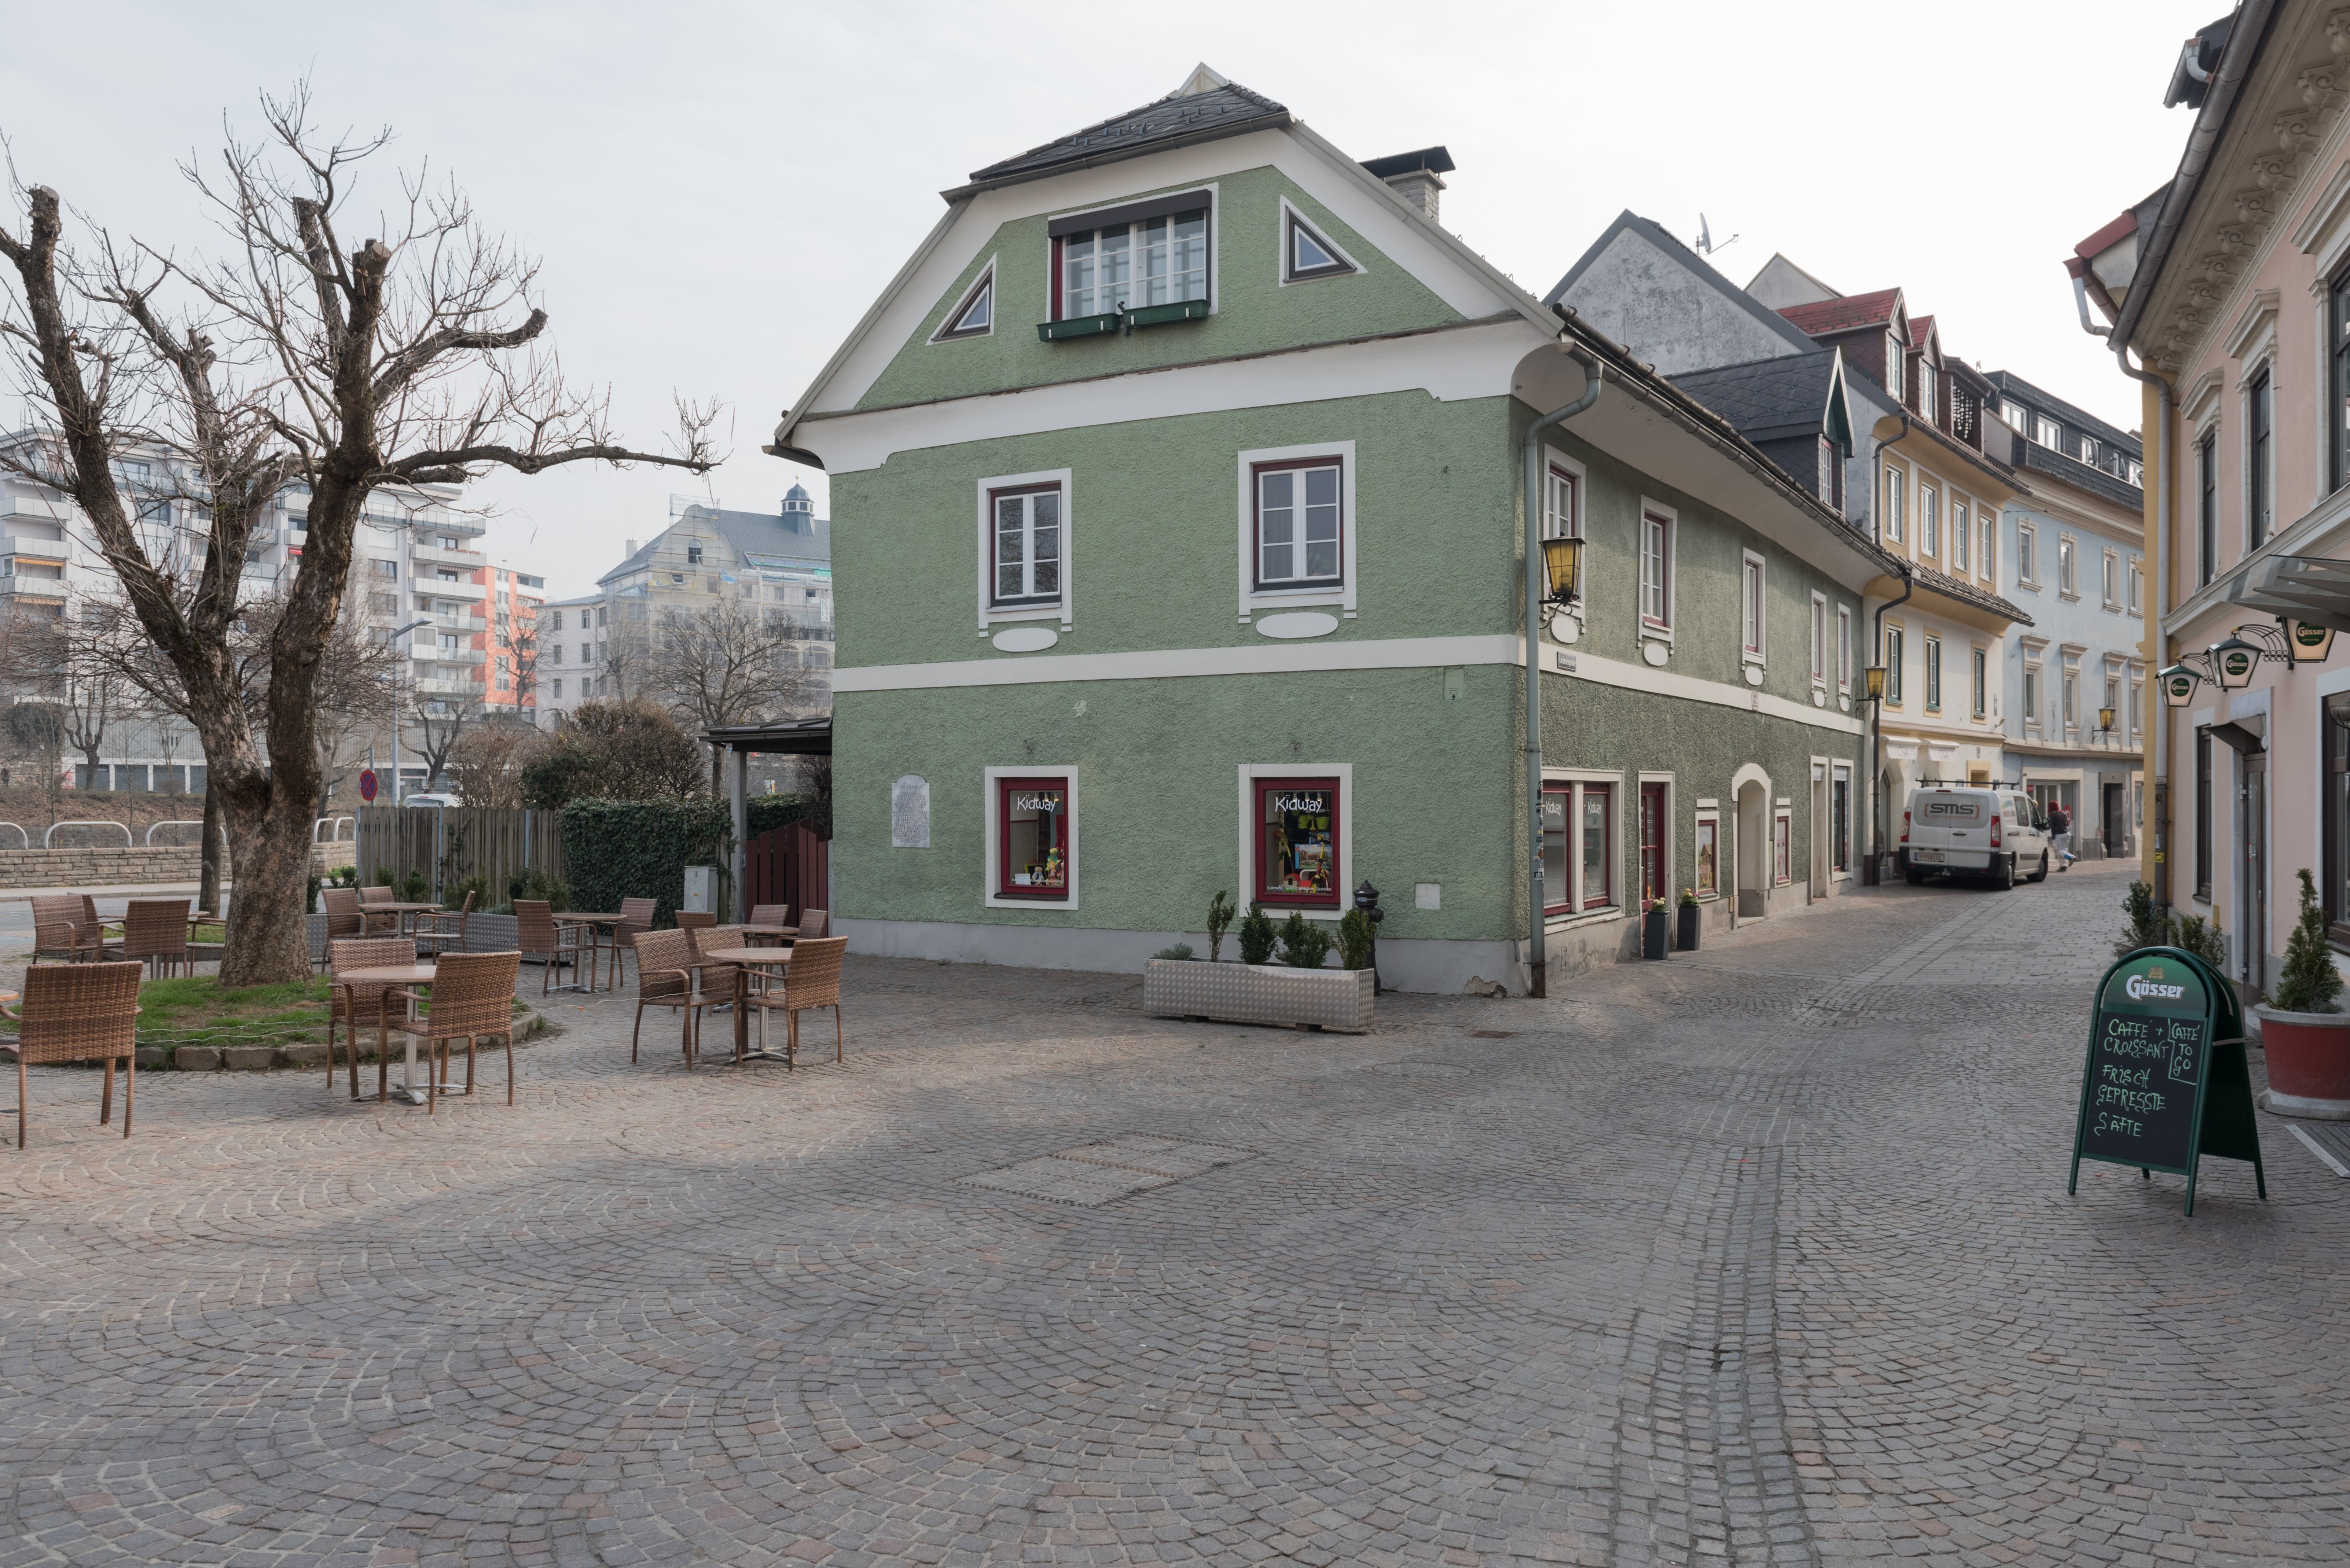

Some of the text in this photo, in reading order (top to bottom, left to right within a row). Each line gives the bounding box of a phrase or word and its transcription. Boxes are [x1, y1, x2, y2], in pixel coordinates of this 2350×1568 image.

[2297, 627, 2325, 637] Gösser
[1016, 794, 1056, 812] Kidway
[1275, 794, 1322, 813] Kidway
[1545, 798, 1562, 816] Kidway
[1587, 799, 1602, 815] Kidway
[2126, 974, 2185, 1000] Gösser
[2178, 1044, 2193, 1056] TO
[2173, 1056, 2191, 1076] GO
